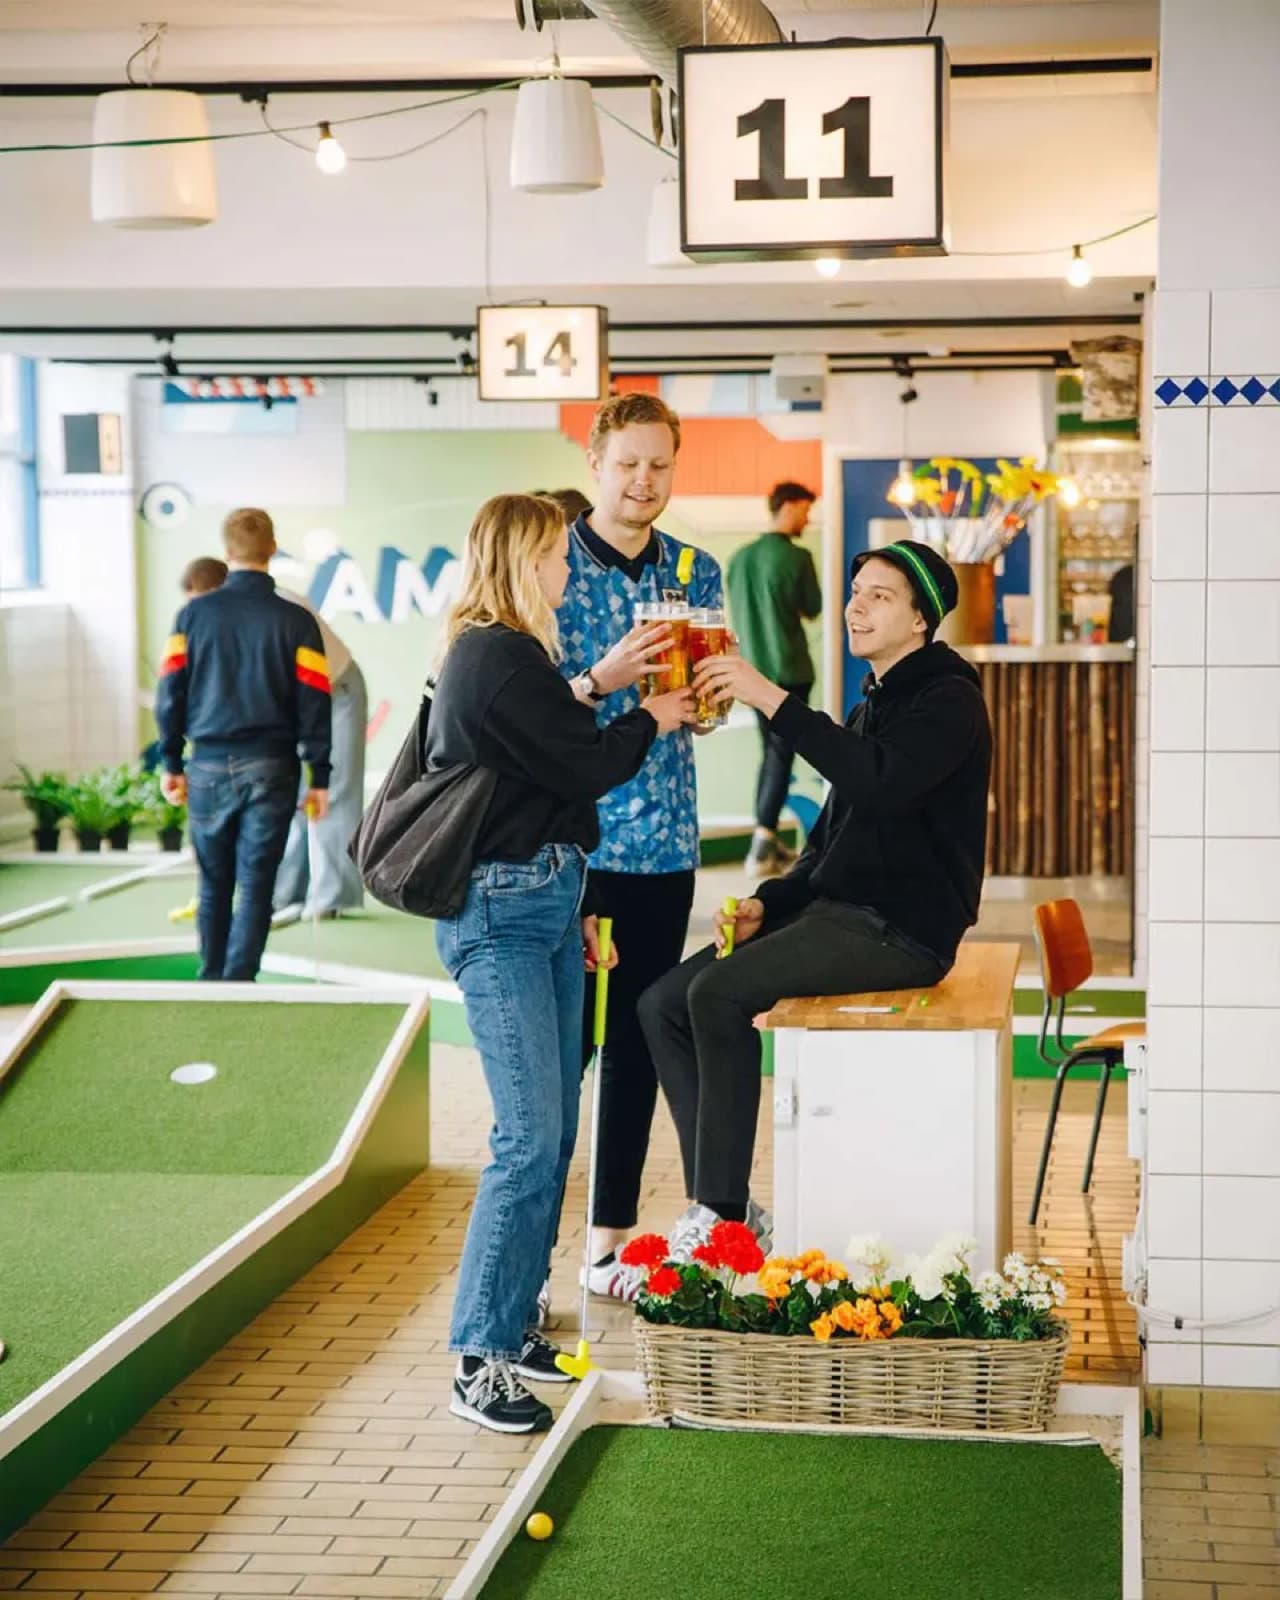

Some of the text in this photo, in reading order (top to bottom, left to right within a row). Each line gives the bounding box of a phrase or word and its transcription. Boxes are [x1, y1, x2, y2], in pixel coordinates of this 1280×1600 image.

[734, 96, 894, 201] 11
[504, 331, 577, 377] 14
[270, 546, 463, 624] AM
